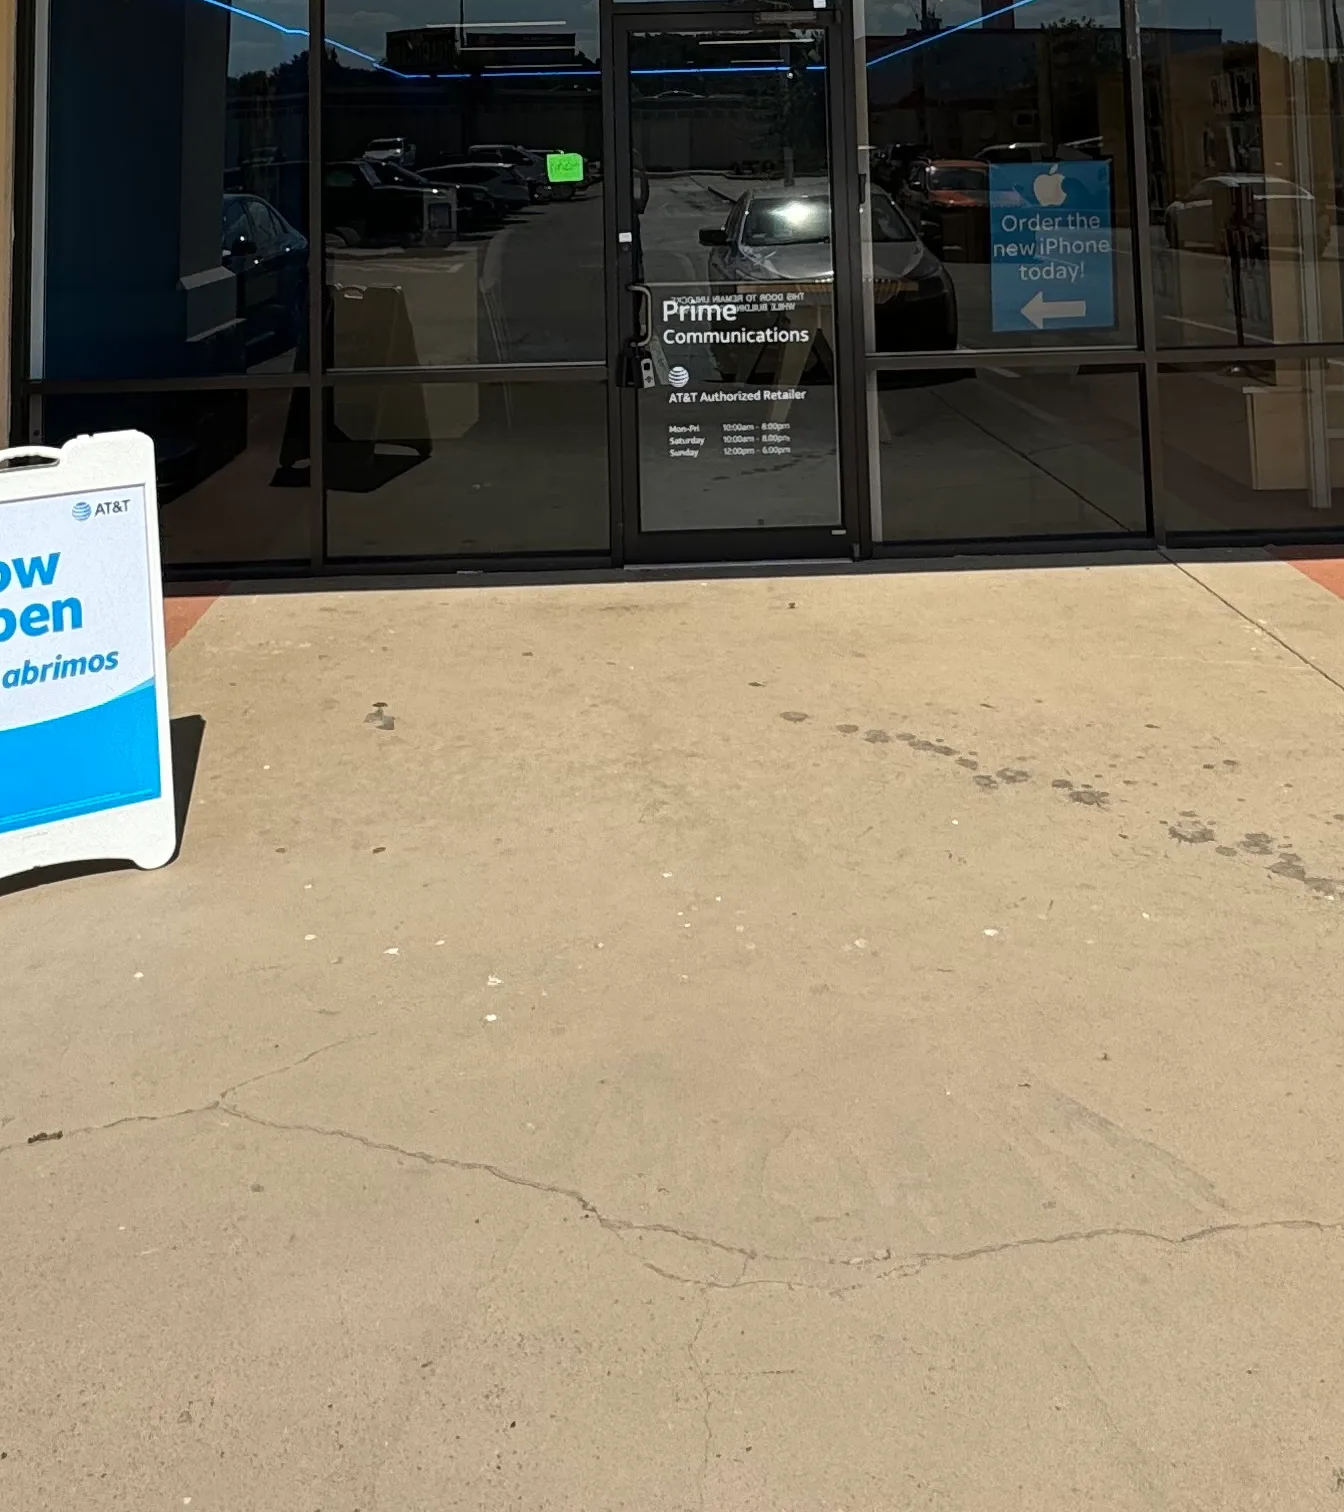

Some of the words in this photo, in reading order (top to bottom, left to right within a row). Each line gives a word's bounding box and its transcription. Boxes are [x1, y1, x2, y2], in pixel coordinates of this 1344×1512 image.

[1001, 213, 1062, 233] Order
[1067, 212, 1101, 230] the
[993, 243, 1035, 257] new
[1039, 238, 1111, 257] iPhone
[1019, 262, 1085, 283] today!
[662, 300, 738, 322] Prime
[663, 327, 810, 345] Communications
[668, 392, 698, 403] AT&T
[699, 390, 761, 402] Authorized
[763, 389, 807, 401] Retailer
[722, 423, 754, 432] 10:00am
[669, 436, 705, 446] Saturday
[722, 435, 755, 444] 10:00am
[669, 448, 699, 458] Sunday
[723, 447, 755, 456] 12:00pm
[94, 498, 131, 518] AT&T
[2, 650, 120, 689] abrimos
